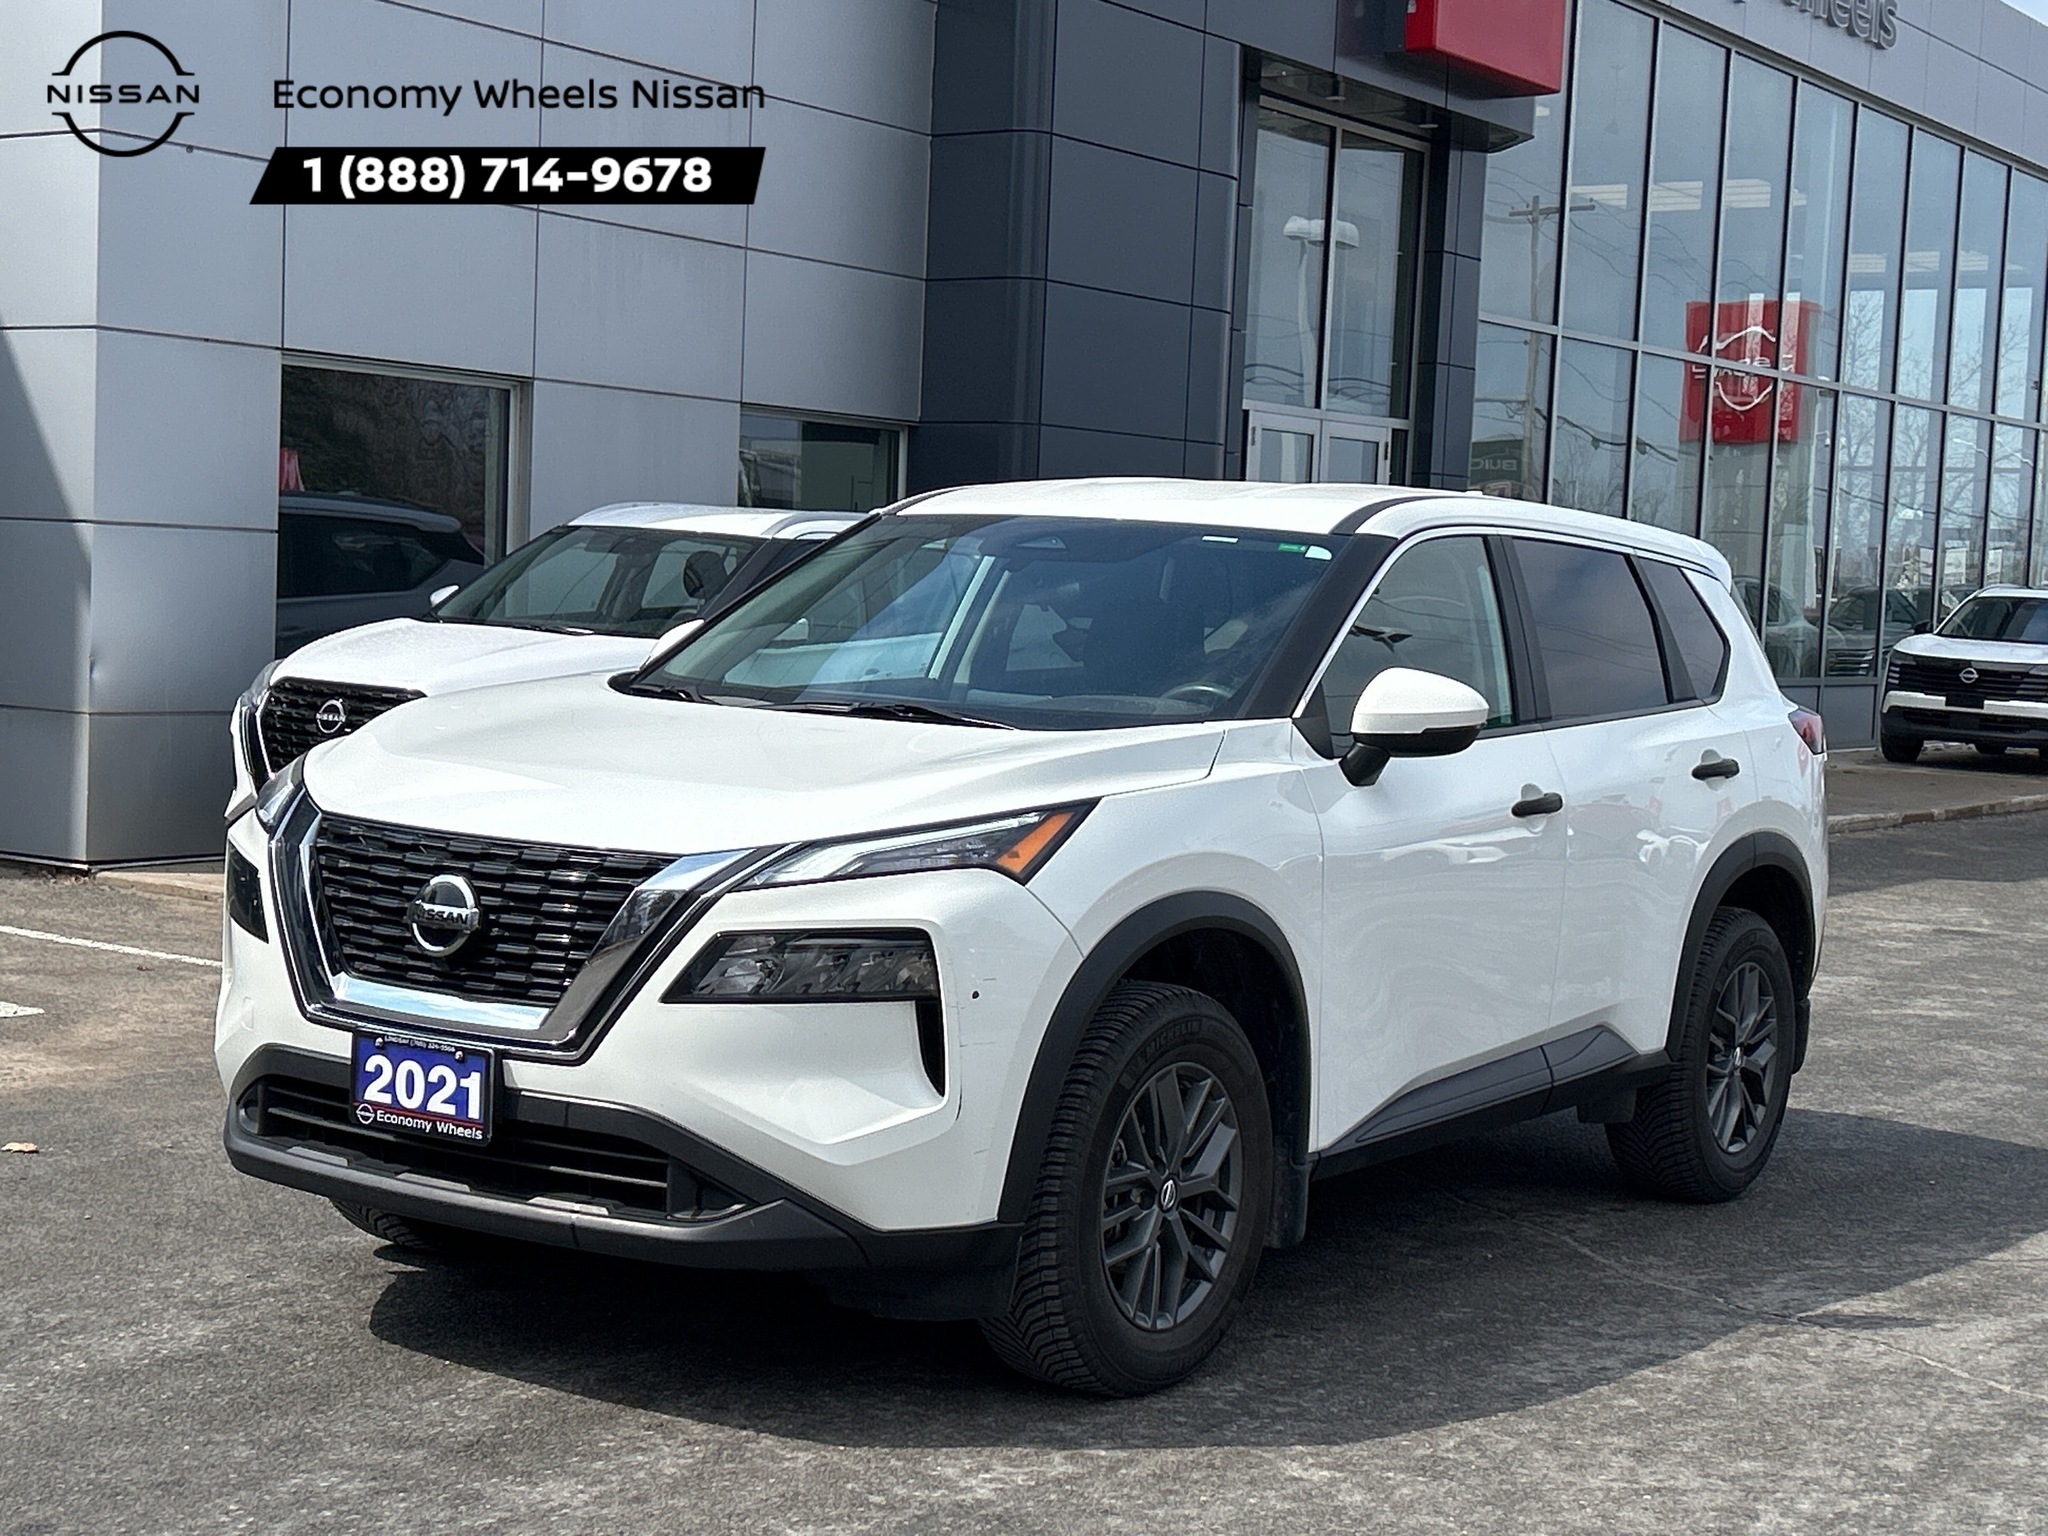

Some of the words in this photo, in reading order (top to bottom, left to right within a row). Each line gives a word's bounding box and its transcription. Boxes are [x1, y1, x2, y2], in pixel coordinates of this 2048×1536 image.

[363, 1054, 481, 1120] 2021
[376, 1110, 432, 1132] Economy
[436, 1121, 483, 1140] Wheels
